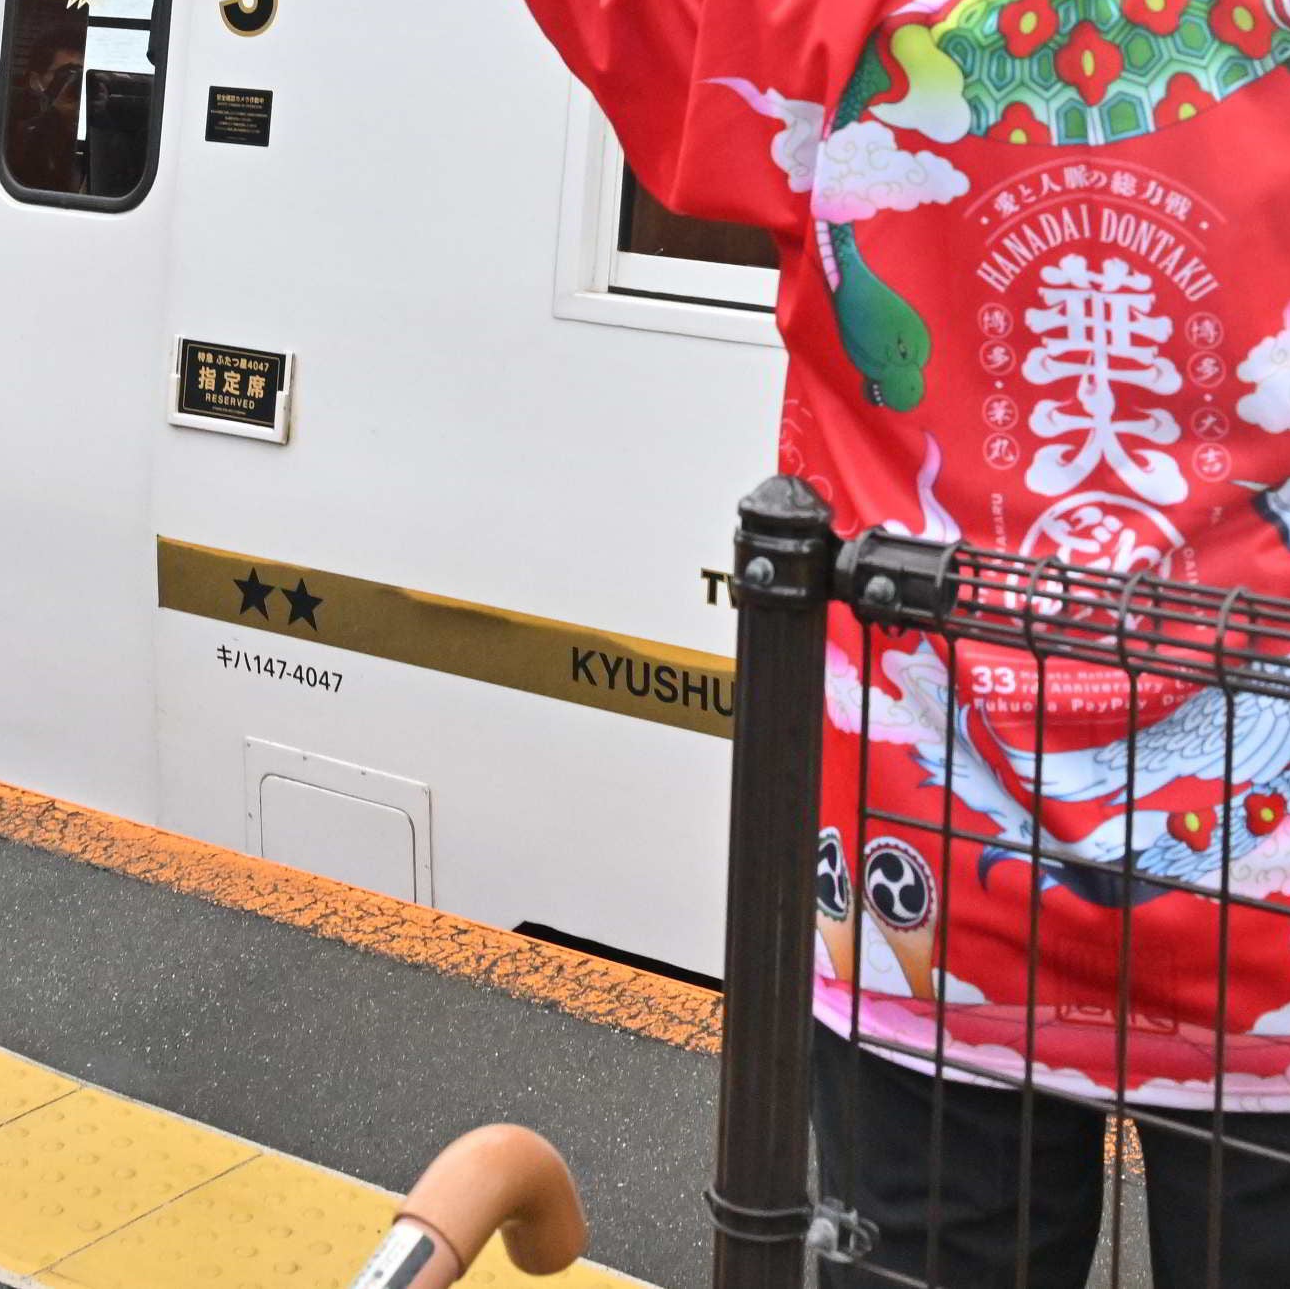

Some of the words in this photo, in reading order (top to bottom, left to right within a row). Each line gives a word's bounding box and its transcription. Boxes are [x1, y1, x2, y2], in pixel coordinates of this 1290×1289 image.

[976, 204, 1091, 294] HANADAI
[1100, 207, 1220, 302] DONTAKU
[198, 365, 266, 399] 指定席
[205, 392, 255, 410] RESERVED
[216, 644, 343, 693] キハ147-4047
[572, 646, 734, 717] KYUSHU
[971, 665, 1016, 695] 33
[974, 698, 1058, 713] Fukuoa
